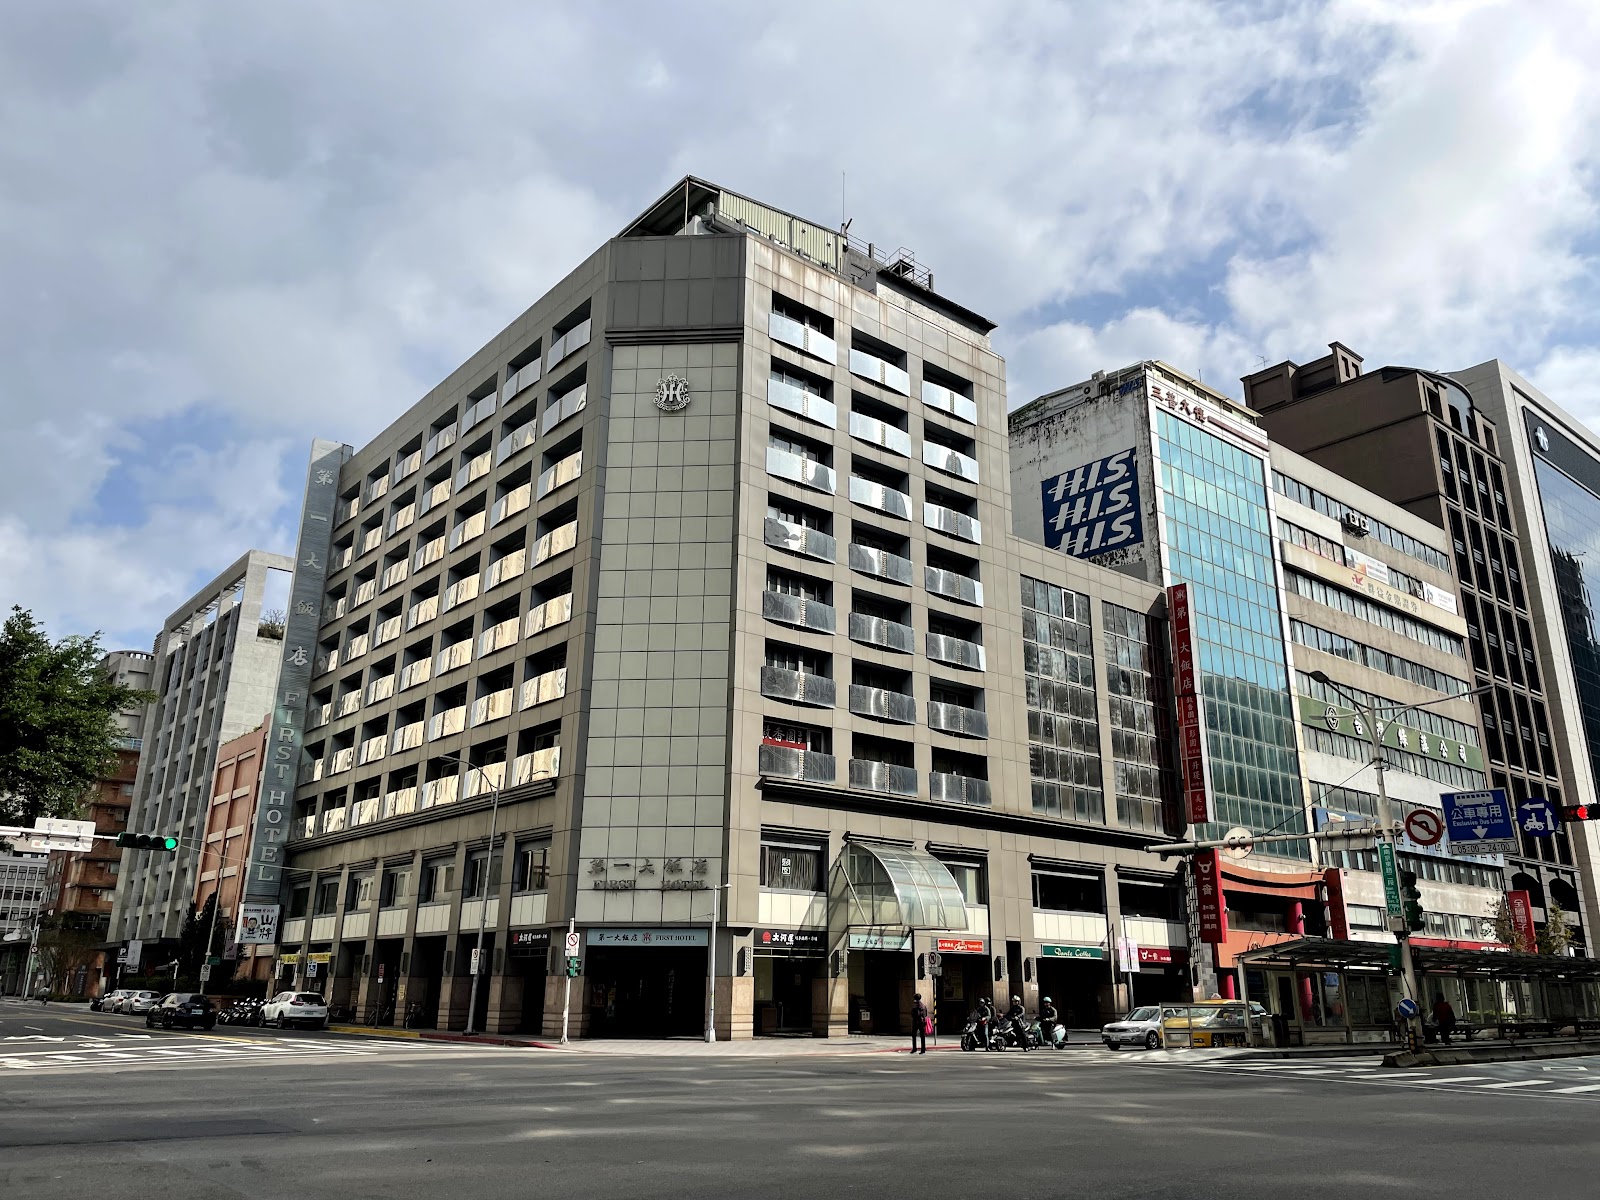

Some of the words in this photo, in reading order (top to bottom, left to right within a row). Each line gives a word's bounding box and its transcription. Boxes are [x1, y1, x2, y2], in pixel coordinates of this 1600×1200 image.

[285, 468, 335, 667] 第一大飯店
[1177, 606, 1192, 690] 第一大飯店
[274, 691, 300, 779] FIRST
[1451, 805, 1502, 820] 公車專用
[258, 791, 287, 882] HOTEL
[587, 857, 708, 875] 第一大飯店
[593, 879, 636, 890] FIRST
[661, 879, 709, 890] HOTEL
[598, 933, 638, 942] 第一大飯店
[771, 932, 795, 943] 大河屋
[1054, 948, 1073, 957] Dante
[1074, 948, 1092, 958] Coffee
